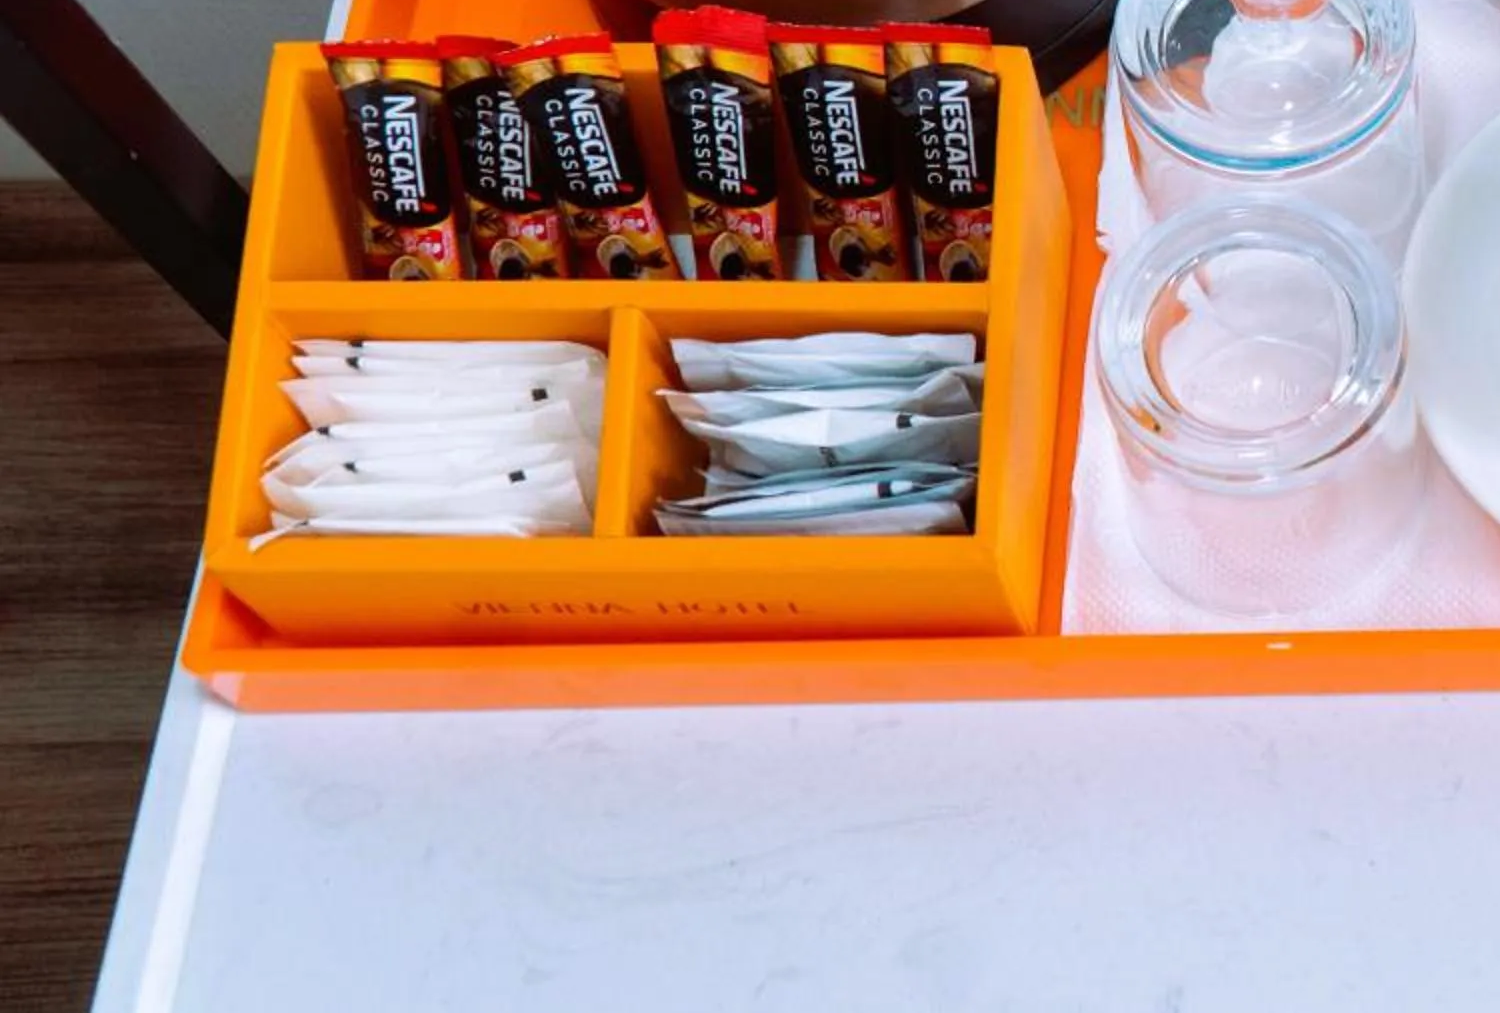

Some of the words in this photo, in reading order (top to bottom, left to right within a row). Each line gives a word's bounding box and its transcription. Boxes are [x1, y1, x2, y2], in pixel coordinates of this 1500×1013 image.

[360, 104, 389, 202] CLASSIC
[476, 95, 497, 188] CLASSIC
[544, 99, 586, 192] CLASSIC
[689, 88, 713, 181] CLASSIC
[803, 88, 830, 177] CLASSIC
[917, 88, 943, 185] CLASSIC
